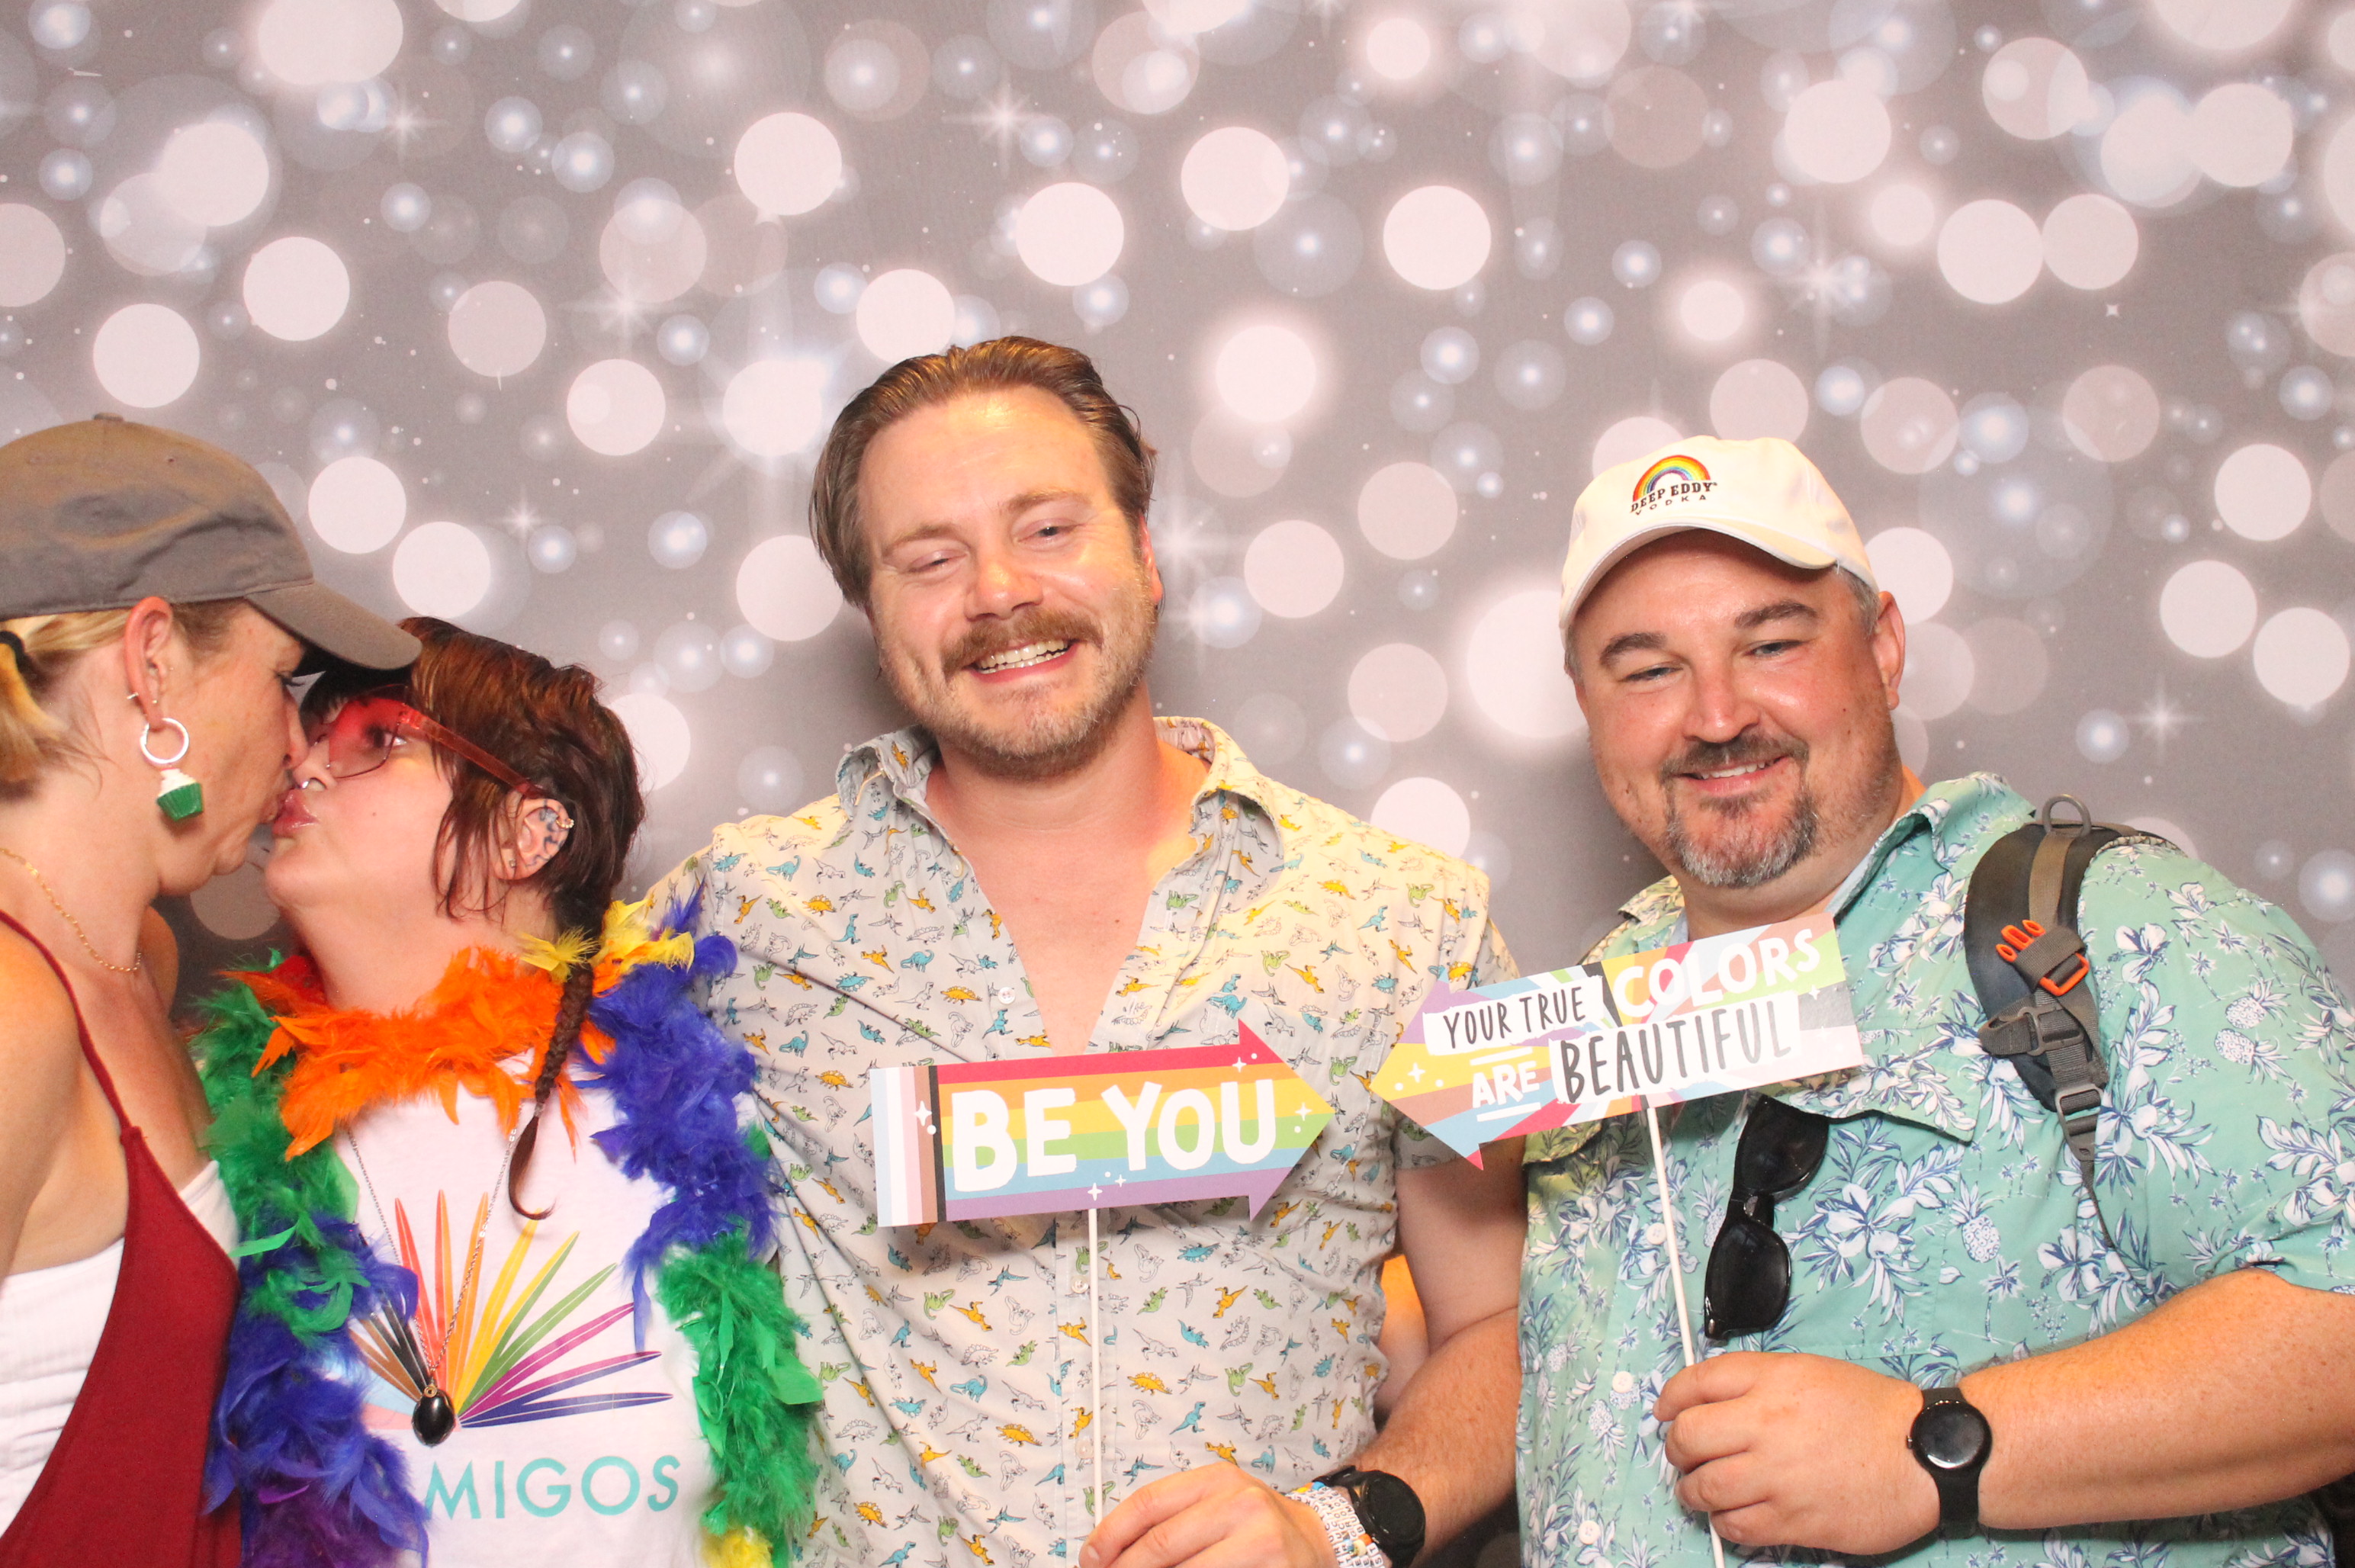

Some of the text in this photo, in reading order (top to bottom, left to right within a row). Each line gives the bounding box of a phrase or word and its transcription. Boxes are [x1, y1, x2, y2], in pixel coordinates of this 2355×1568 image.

[1630, 481, 1714, 513] DEEP EDDY
[1634, 494, 1707, 516] VODKA
[1442, 927, 1822, 1050] YOUR TRUE COLORS
[1471, 998, 1792, 1109] ARE BEAUTIFUL
[950, 1078, 1277, 1193] BE YOU
[425, 1454, 681, 1520] MIGOS
